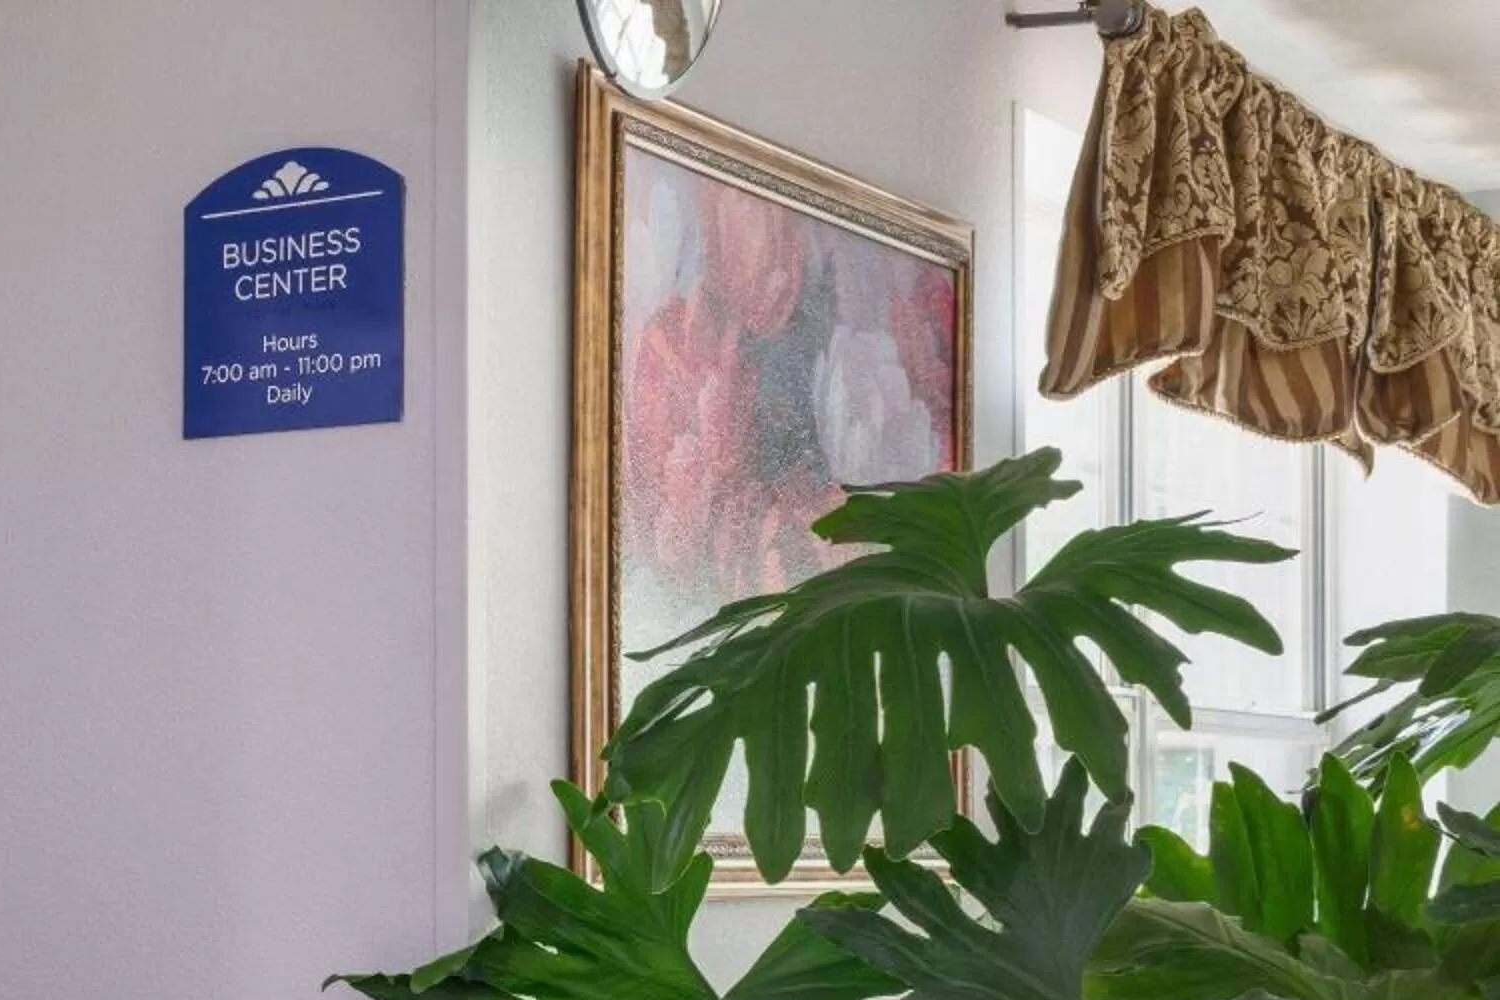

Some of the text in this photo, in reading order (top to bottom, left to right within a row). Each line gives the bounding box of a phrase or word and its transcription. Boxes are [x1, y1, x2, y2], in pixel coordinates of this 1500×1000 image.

[222, 227, 361, 269] BUSINESS
[234, 264, 347, 301] CENTER
[262, 333, 318, 353] Hours
[202, 364, 243, 385] 7:00
[249, 362, 277, 381] am
[298, 353, 343, 376] 11:00
[350, 352, 382, 374] pm
[266, 383, 313, 406] Daily
